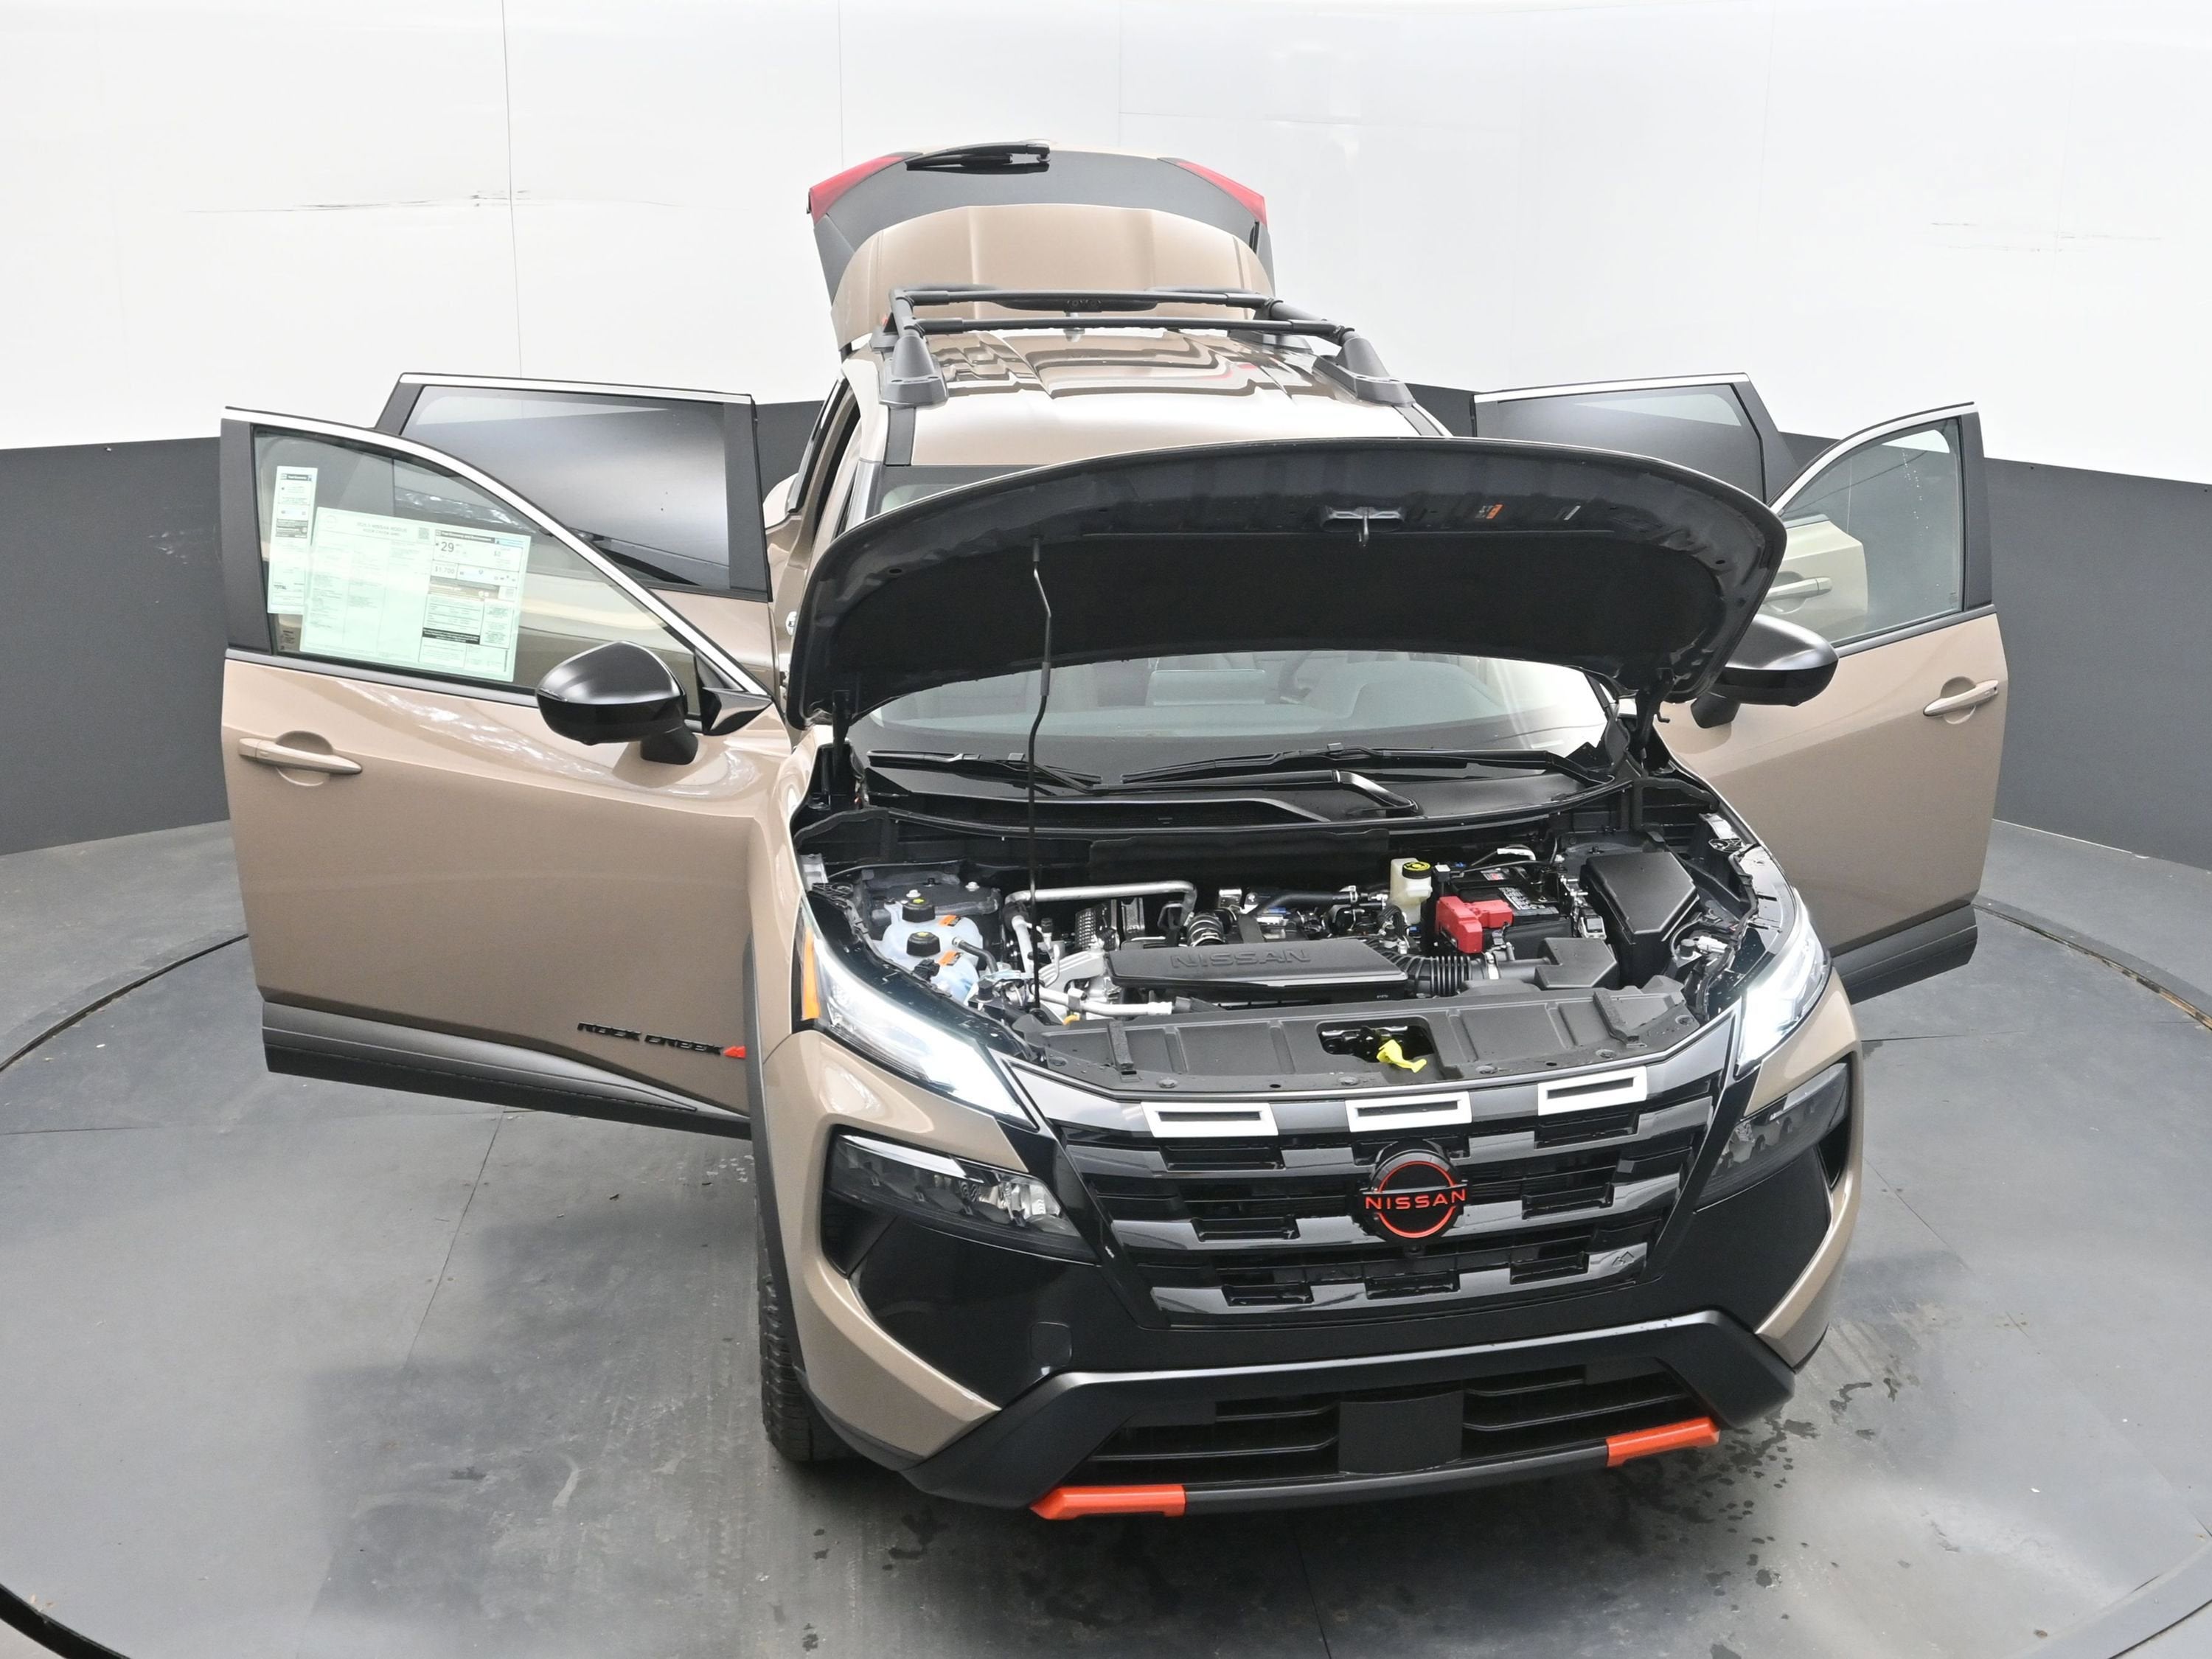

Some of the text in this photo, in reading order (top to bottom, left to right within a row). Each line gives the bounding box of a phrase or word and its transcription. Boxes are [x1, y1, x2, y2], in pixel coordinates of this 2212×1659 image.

[440, 541, 455, 553] 29
[1170, 949, 1312, 969] NISSAN
[577, 1021, 723, 1055] ROCK CREEK
[1365, 1189, 1466, 1210] NISSAN
